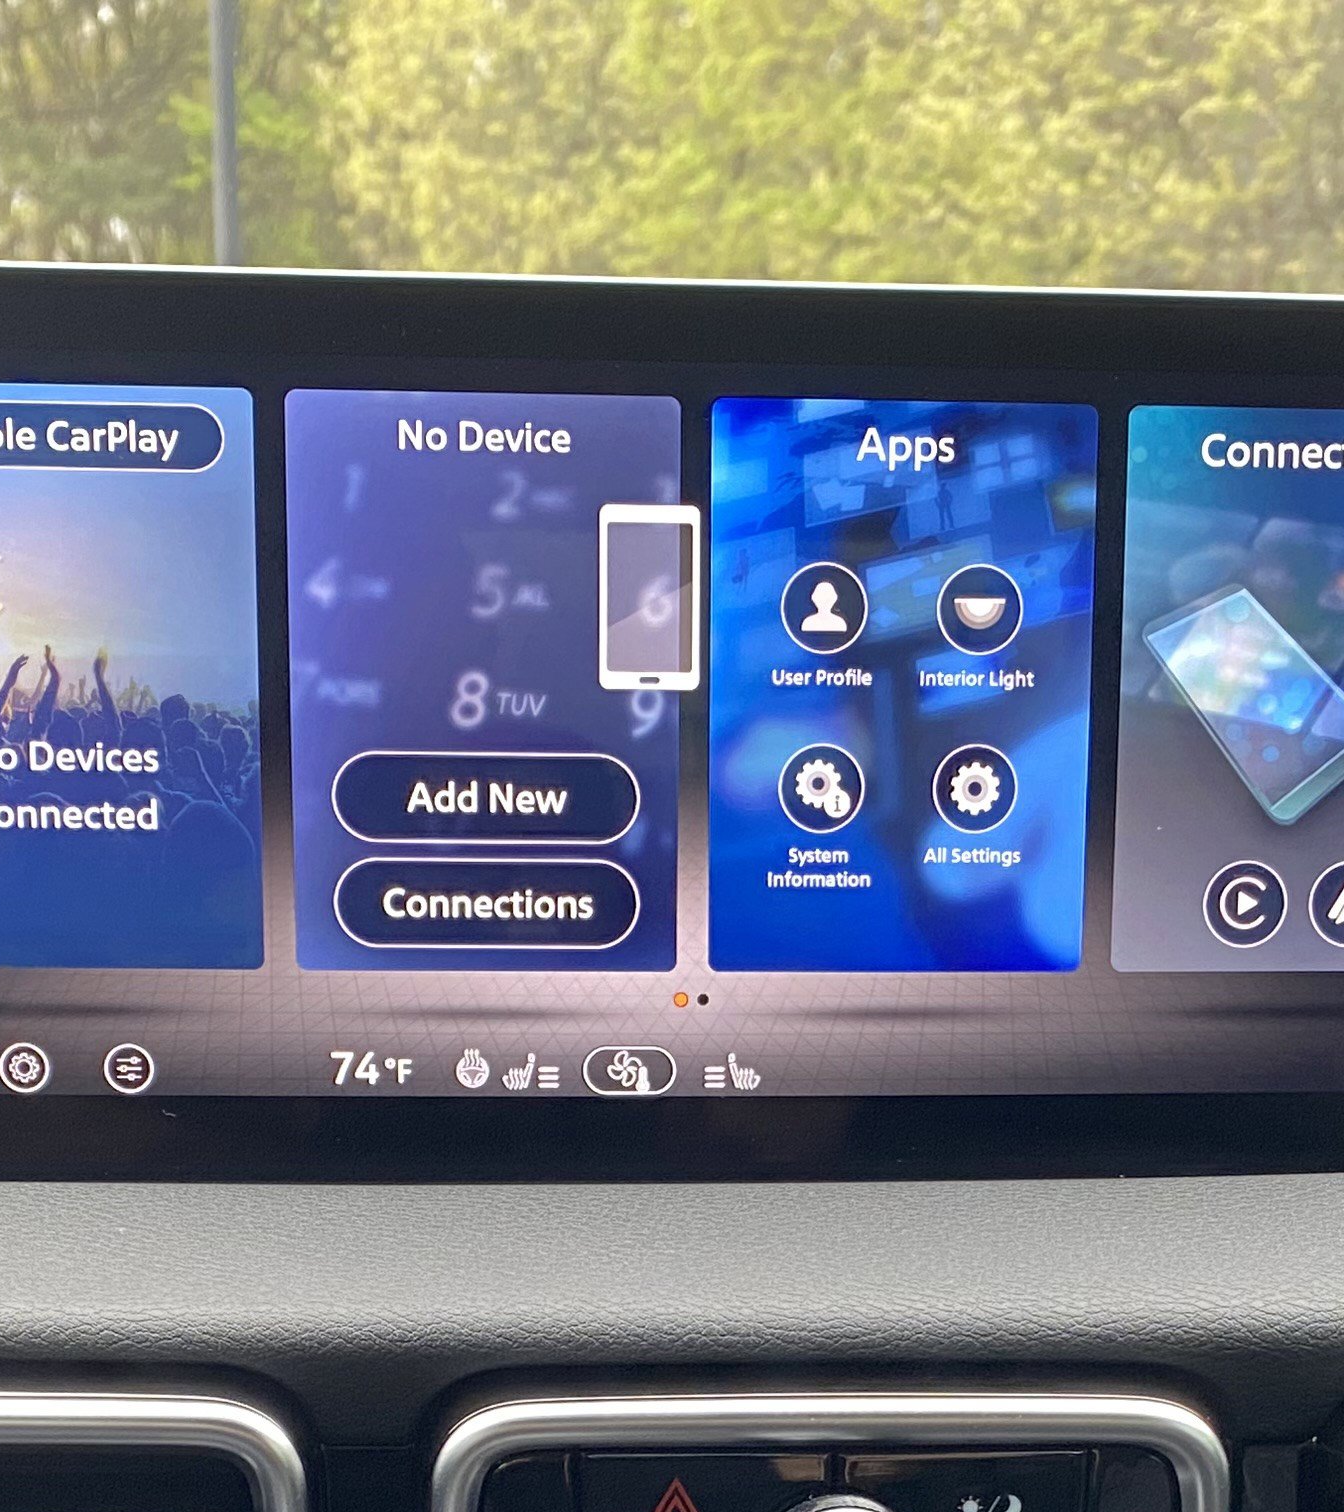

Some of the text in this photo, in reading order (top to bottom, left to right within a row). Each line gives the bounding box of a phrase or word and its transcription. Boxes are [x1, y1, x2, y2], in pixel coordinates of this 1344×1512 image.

[46, 419, 179, 462] CarPlay
[398, 419, 571, 454] No Device
[855, 427, 955, 472] Apps
[471, 564, 510, 618] 5
[641, 574, 672, 627] 6
[771, 668, 873, 686] User Profile
[919, 669, 1035, 691] Interior Light
[450, 671, 547, 728] 8 TUV
[630, 689, 665, 739] 9
[29, 740, 160, 773] Devices
[406, 780, 568, 815] Add New
[788, 847, 849, 868] System
[923, 846, 1021, 868] All Settings
[767, 870, 871, 888] Information
[382, 887, 594, 920] Connections
